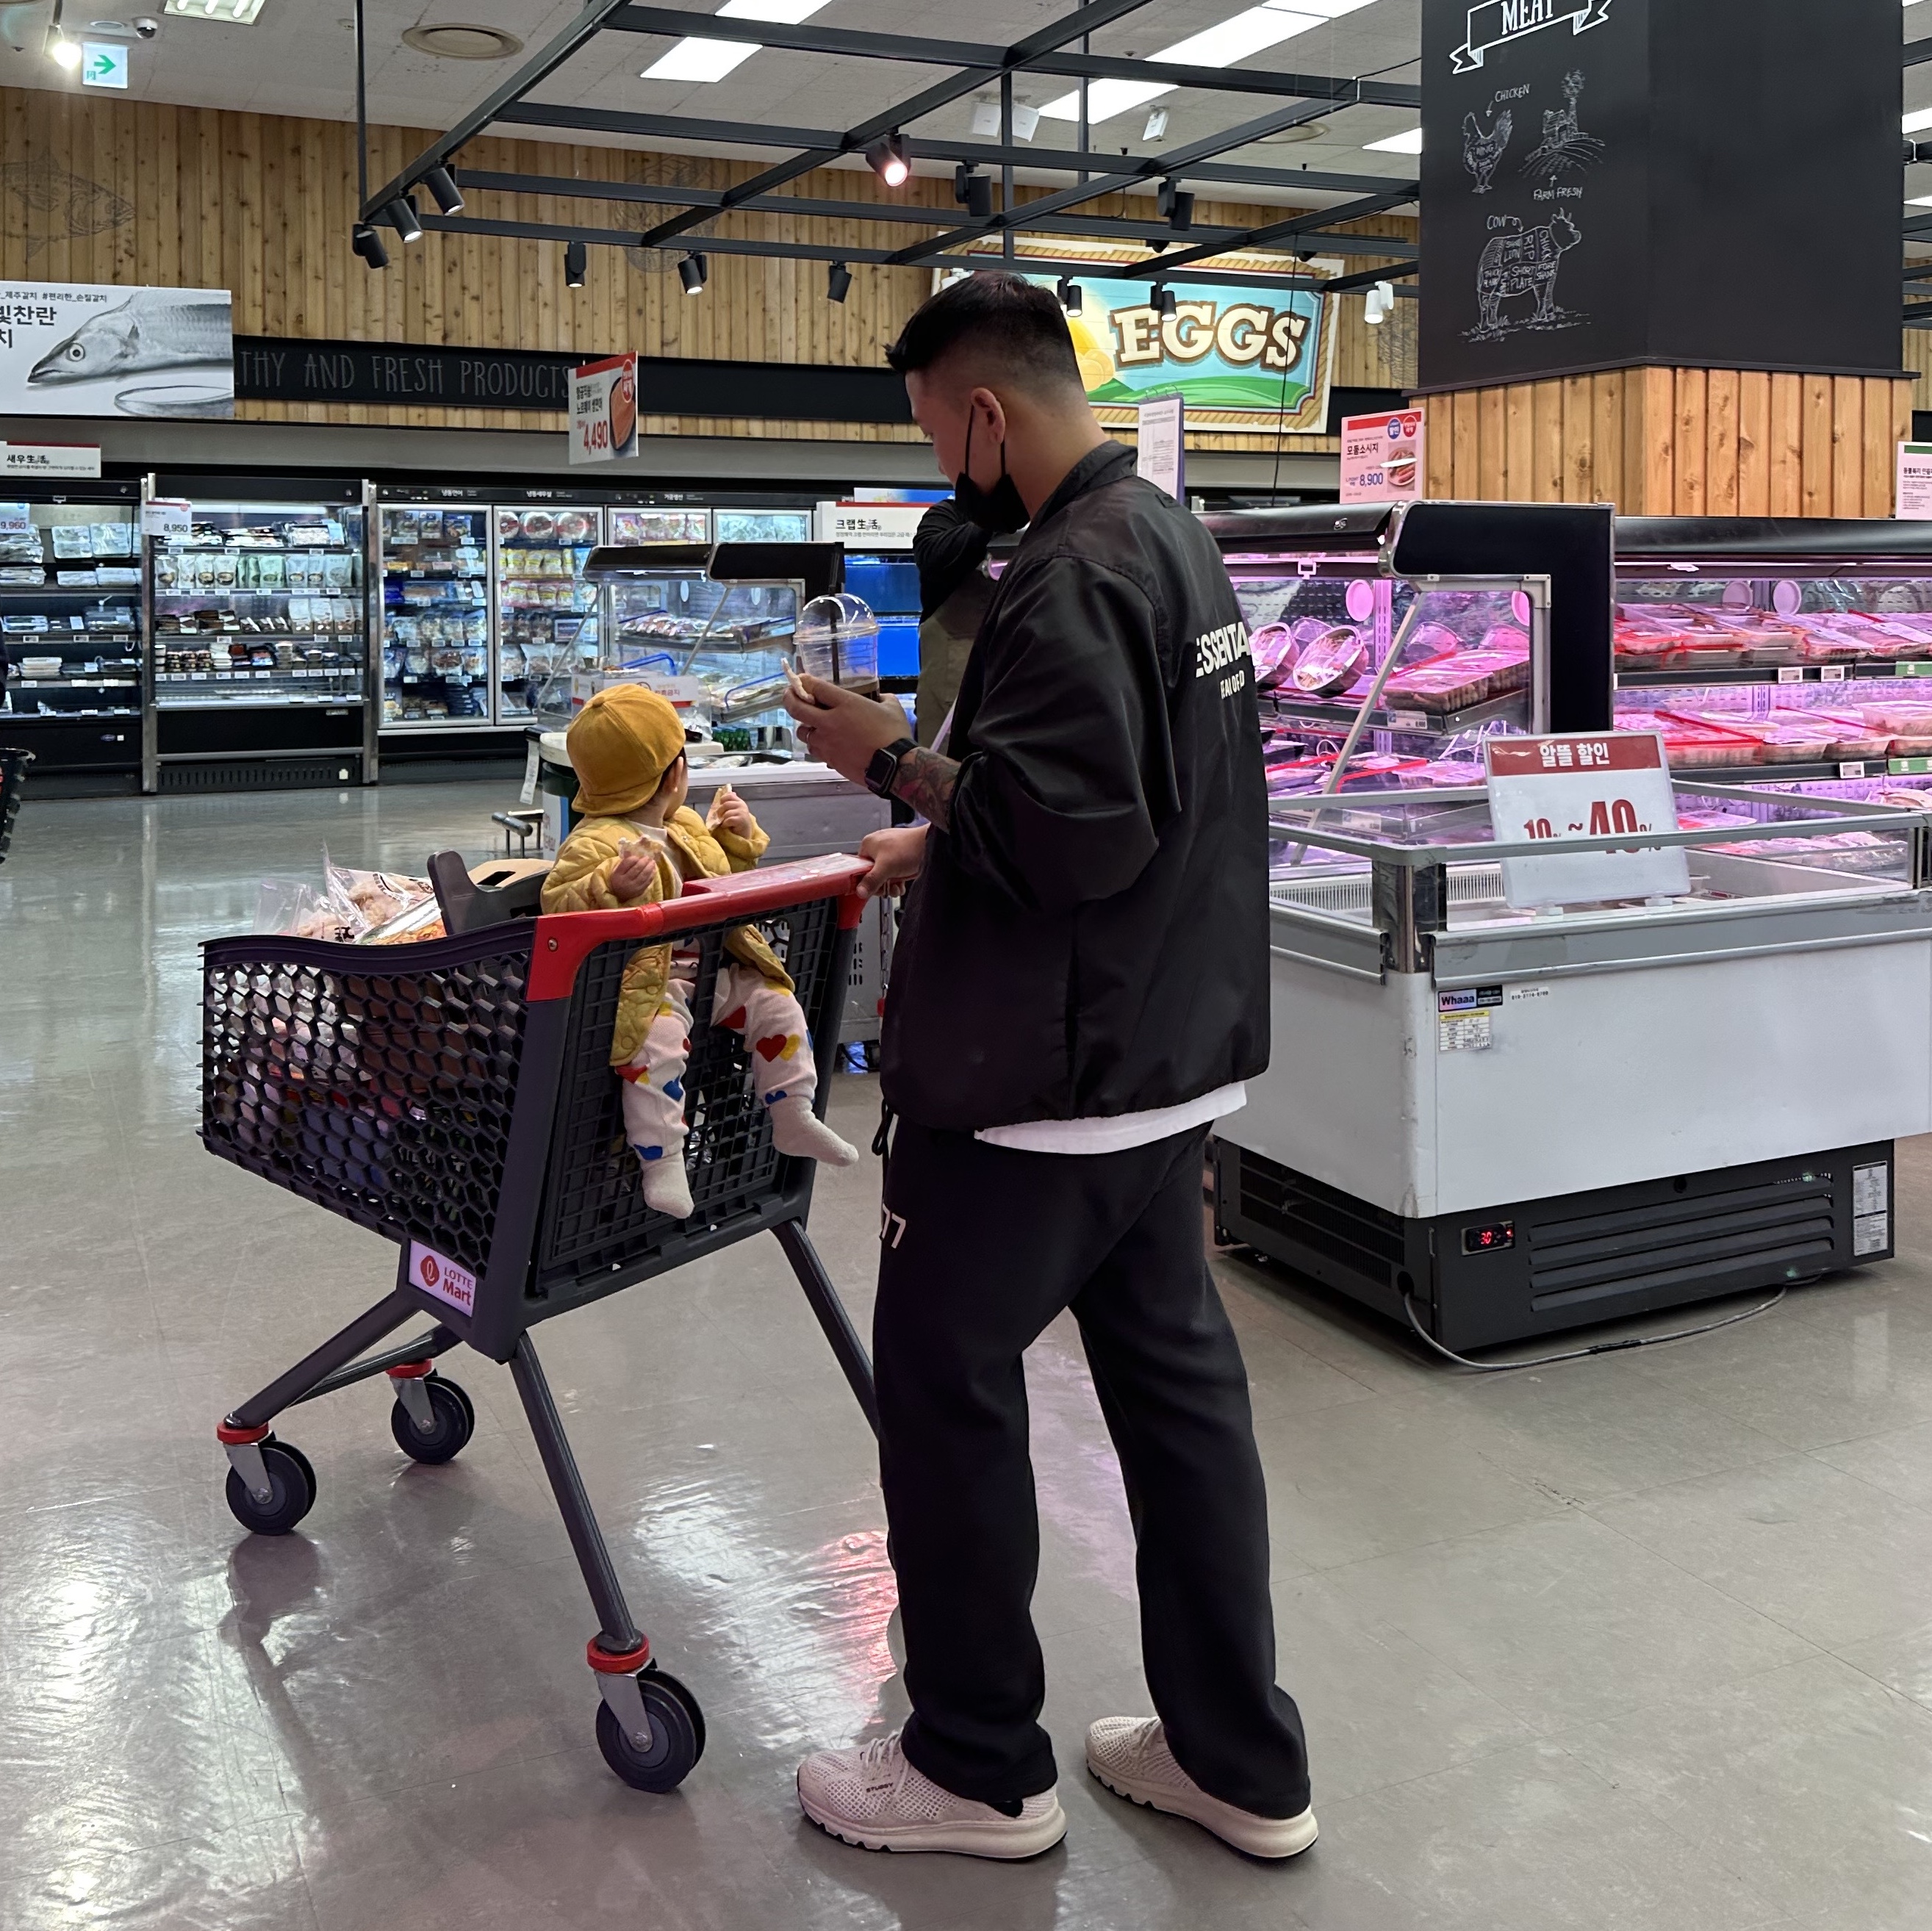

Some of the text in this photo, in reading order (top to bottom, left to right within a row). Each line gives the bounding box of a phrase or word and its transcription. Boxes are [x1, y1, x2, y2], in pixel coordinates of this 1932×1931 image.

[1501, 0, 1553, 35] MEAT
[1495, 84, 1531, 102] CHICKEN
[1534, 187, 1583, 201] FARM FRESH
[1487, 215, 1507, 230] COW
[1510, 276, 1533, 292] PLATE
[1112, 303, 1307, 369] EGGS
[235, 350, 286, 388] THY
[304, 353, 355, 389] AND
[371, 355, 443, 395] FRESH
[583, 420, 608, 456] 4,490
[1360, 472, 1383, 487] 8,900
[163, 523, 188, 533] 8,950
[1539, 742, 1610, 768] 알뜰 할인
[444, 1267, 473, 1290] LOTTE
[442, 1279, 472, 1306] Mart
